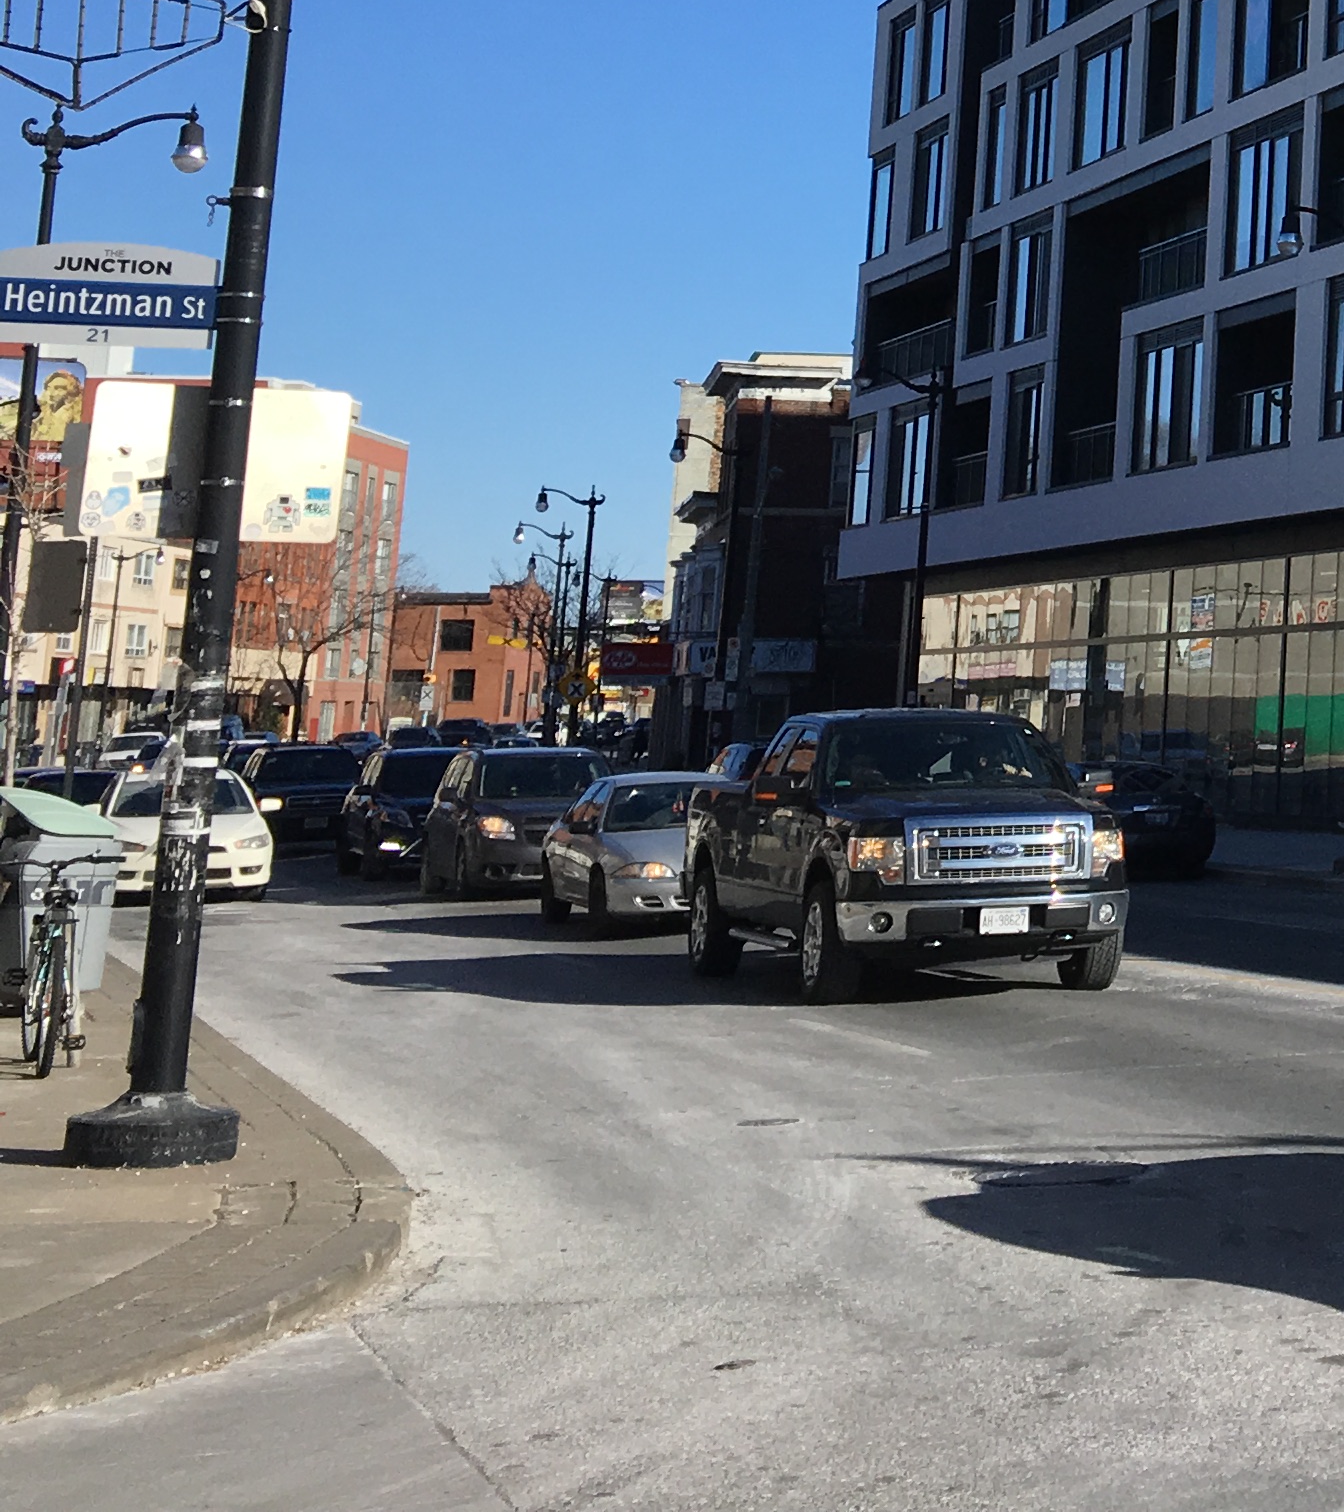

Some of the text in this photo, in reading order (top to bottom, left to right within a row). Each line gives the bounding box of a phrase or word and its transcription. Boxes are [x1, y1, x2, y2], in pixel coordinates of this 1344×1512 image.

[104, 249, 125, 258] THE
[54, 256, 173, 275] JUNCTION
[4, 283, 206, 319] Heintzman St
[86, 328, 109, 343] 21
[982, 915, 994, 927] AH
